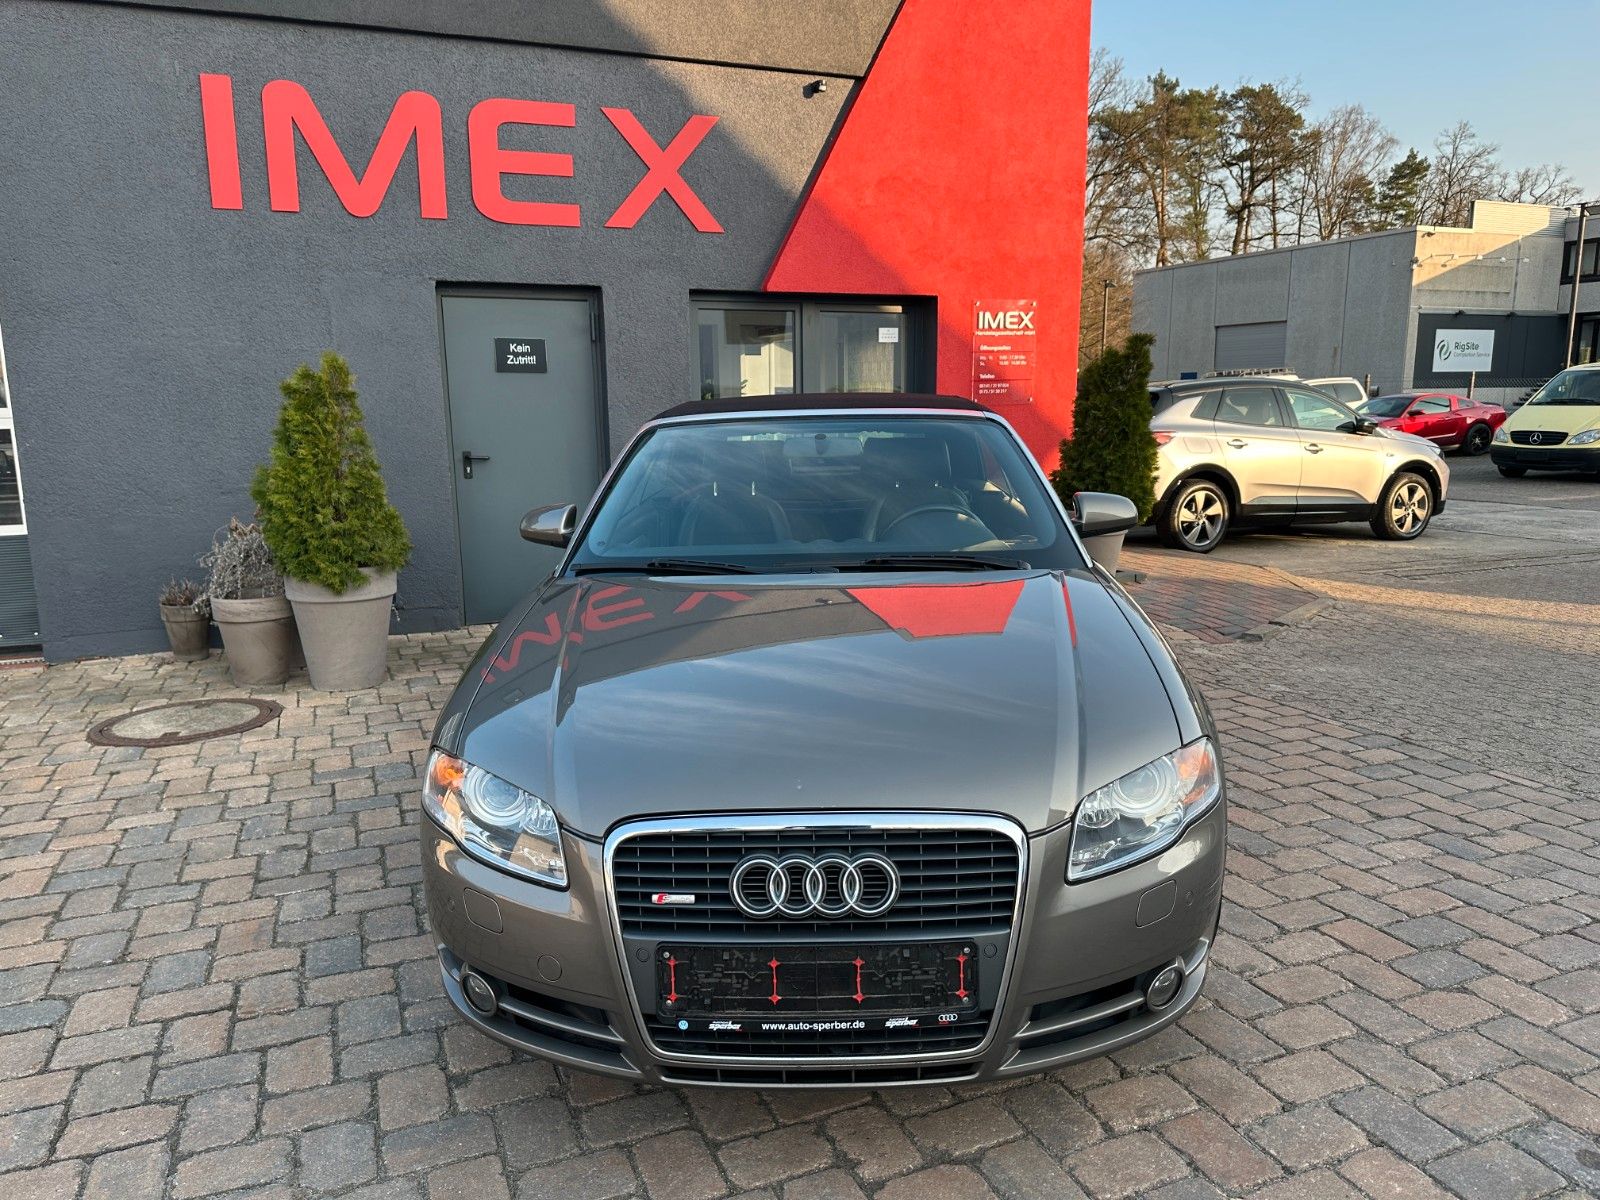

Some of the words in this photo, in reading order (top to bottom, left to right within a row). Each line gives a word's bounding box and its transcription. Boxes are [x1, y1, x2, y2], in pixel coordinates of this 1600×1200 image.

[200, 73, 725, 234] IMEX
[978, 311, 1034, 329] IMEX
[509, 343, 531, 353] Kein
[1454, 342, 1480, 352] RigSite
[506, 355, 536, 365] Zutritt!
[761, 1019, 866, 1032] www.auto-sperber.de
